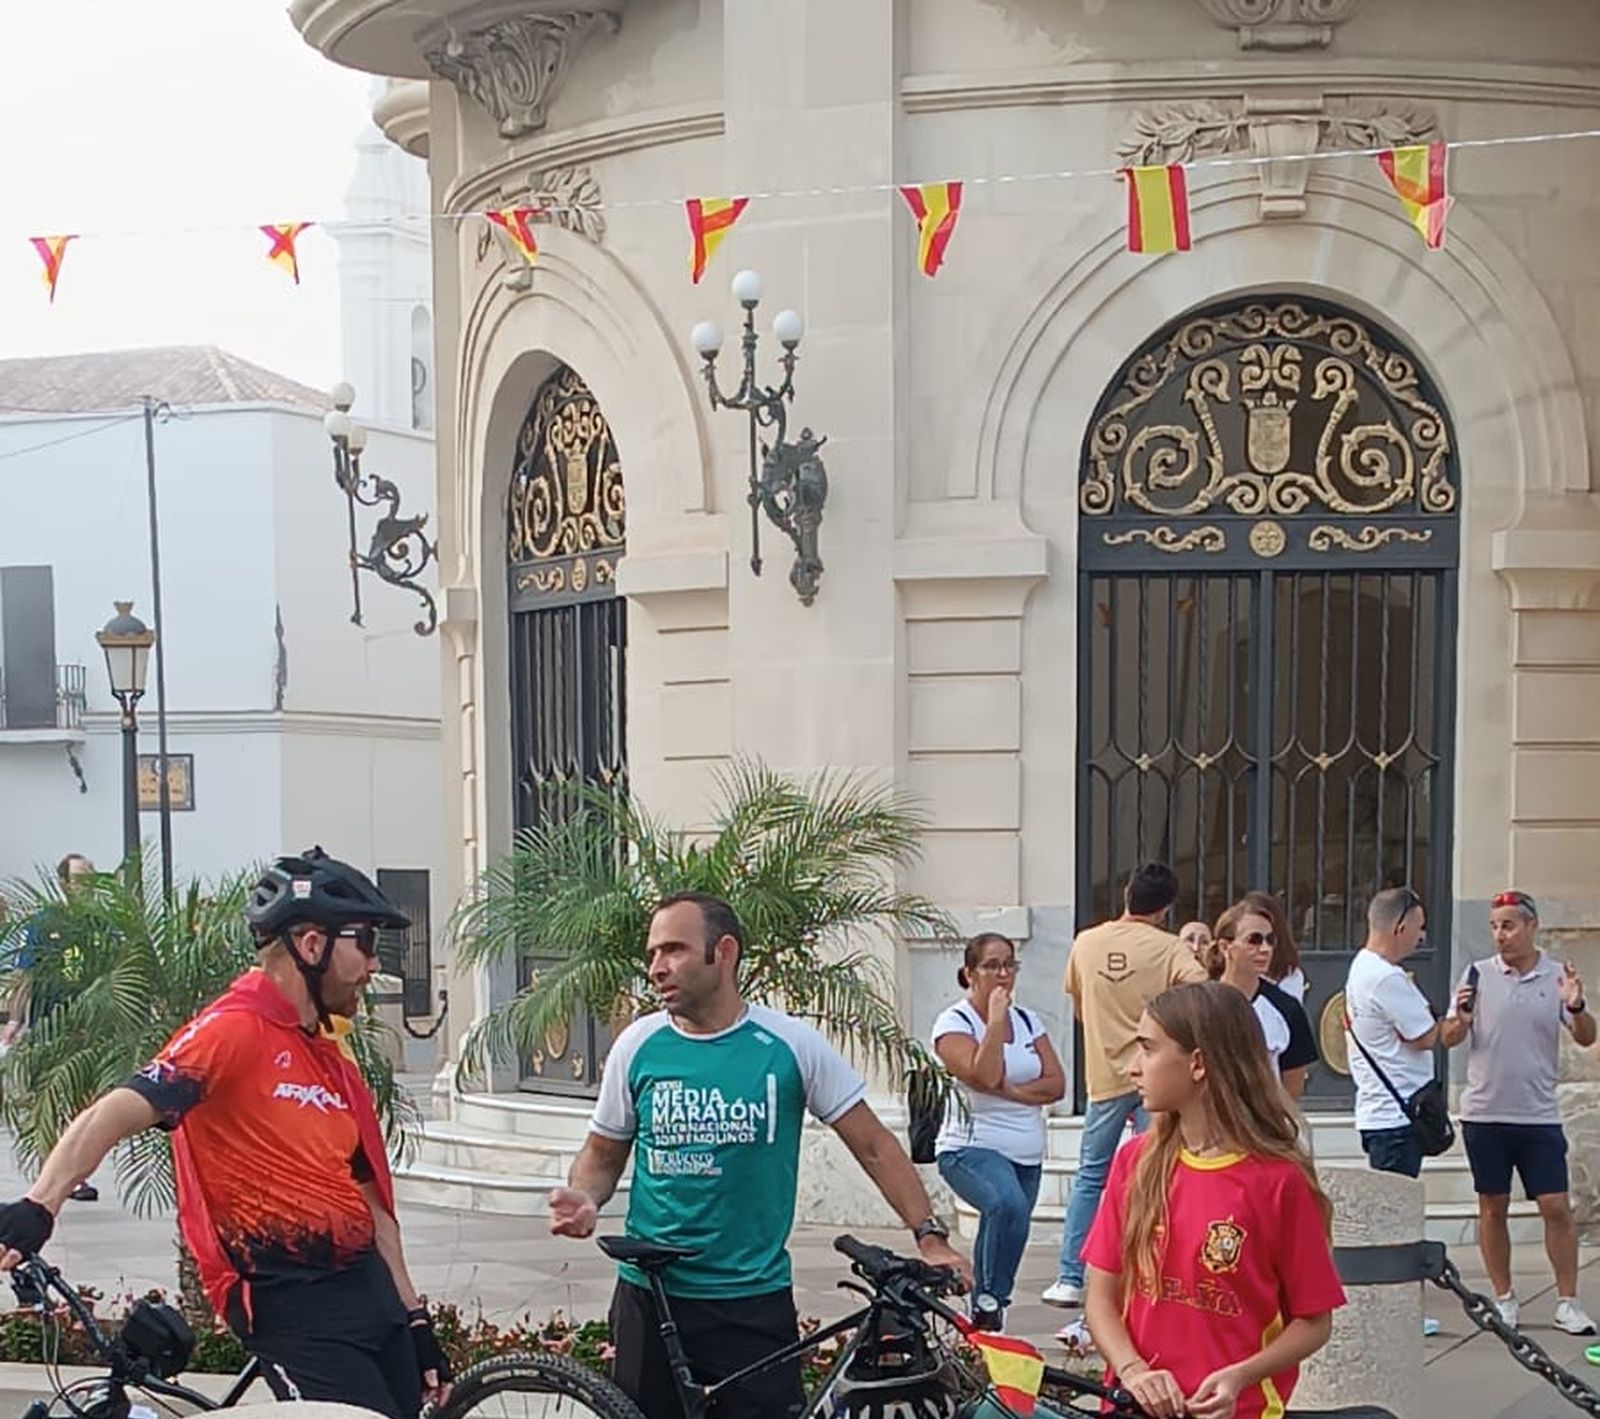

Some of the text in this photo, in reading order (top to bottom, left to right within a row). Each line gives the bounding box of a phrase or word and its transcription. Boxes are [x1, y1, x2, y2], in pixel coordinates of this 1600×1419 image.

[652, 1088, 723, 1107] MEDIA
[652, 1097, 766, 1124] MARATÓN
[652, 1119, 759, 1135] INTERNACIONAL
